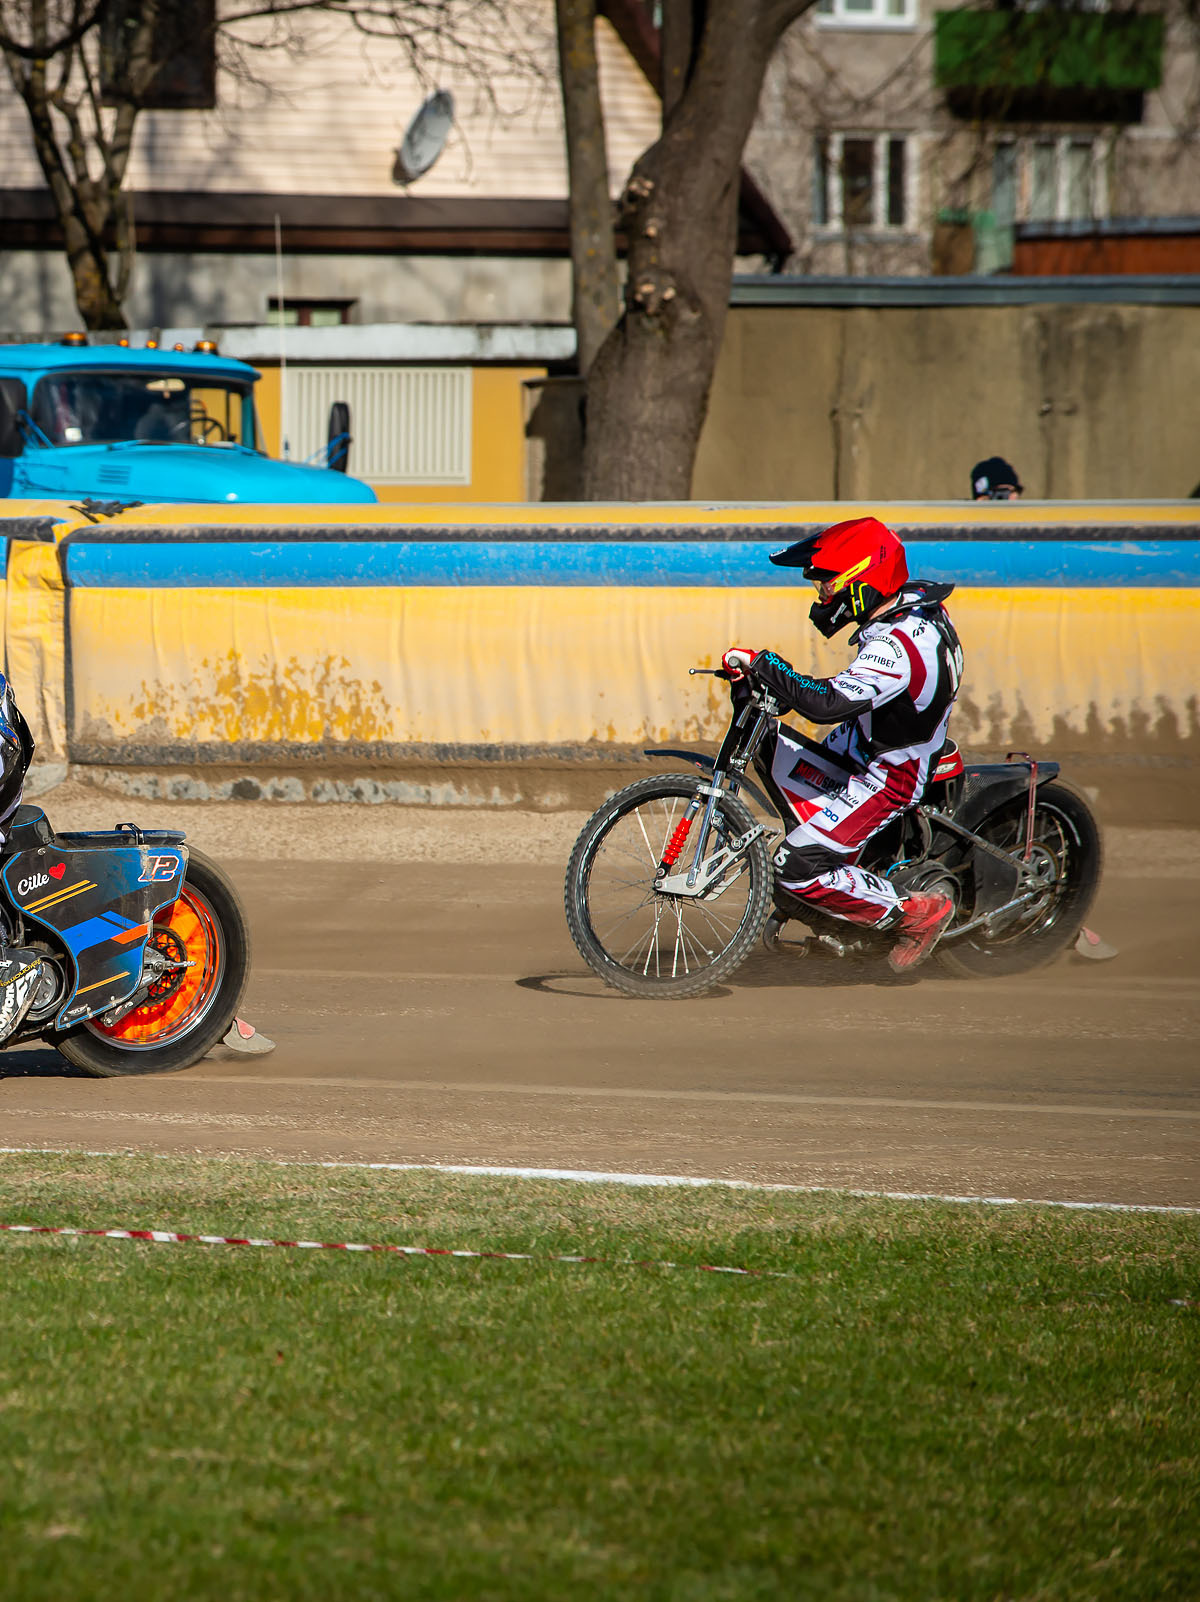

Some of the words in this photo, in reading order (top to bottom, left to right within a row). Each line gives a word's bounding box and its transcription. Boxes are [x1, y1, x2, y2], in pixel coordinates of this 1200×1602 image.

[859, 653, 896, 669] OPTIBET
[138, 855, 179, 882] 12
[17, 872, 50, 896] Cille
